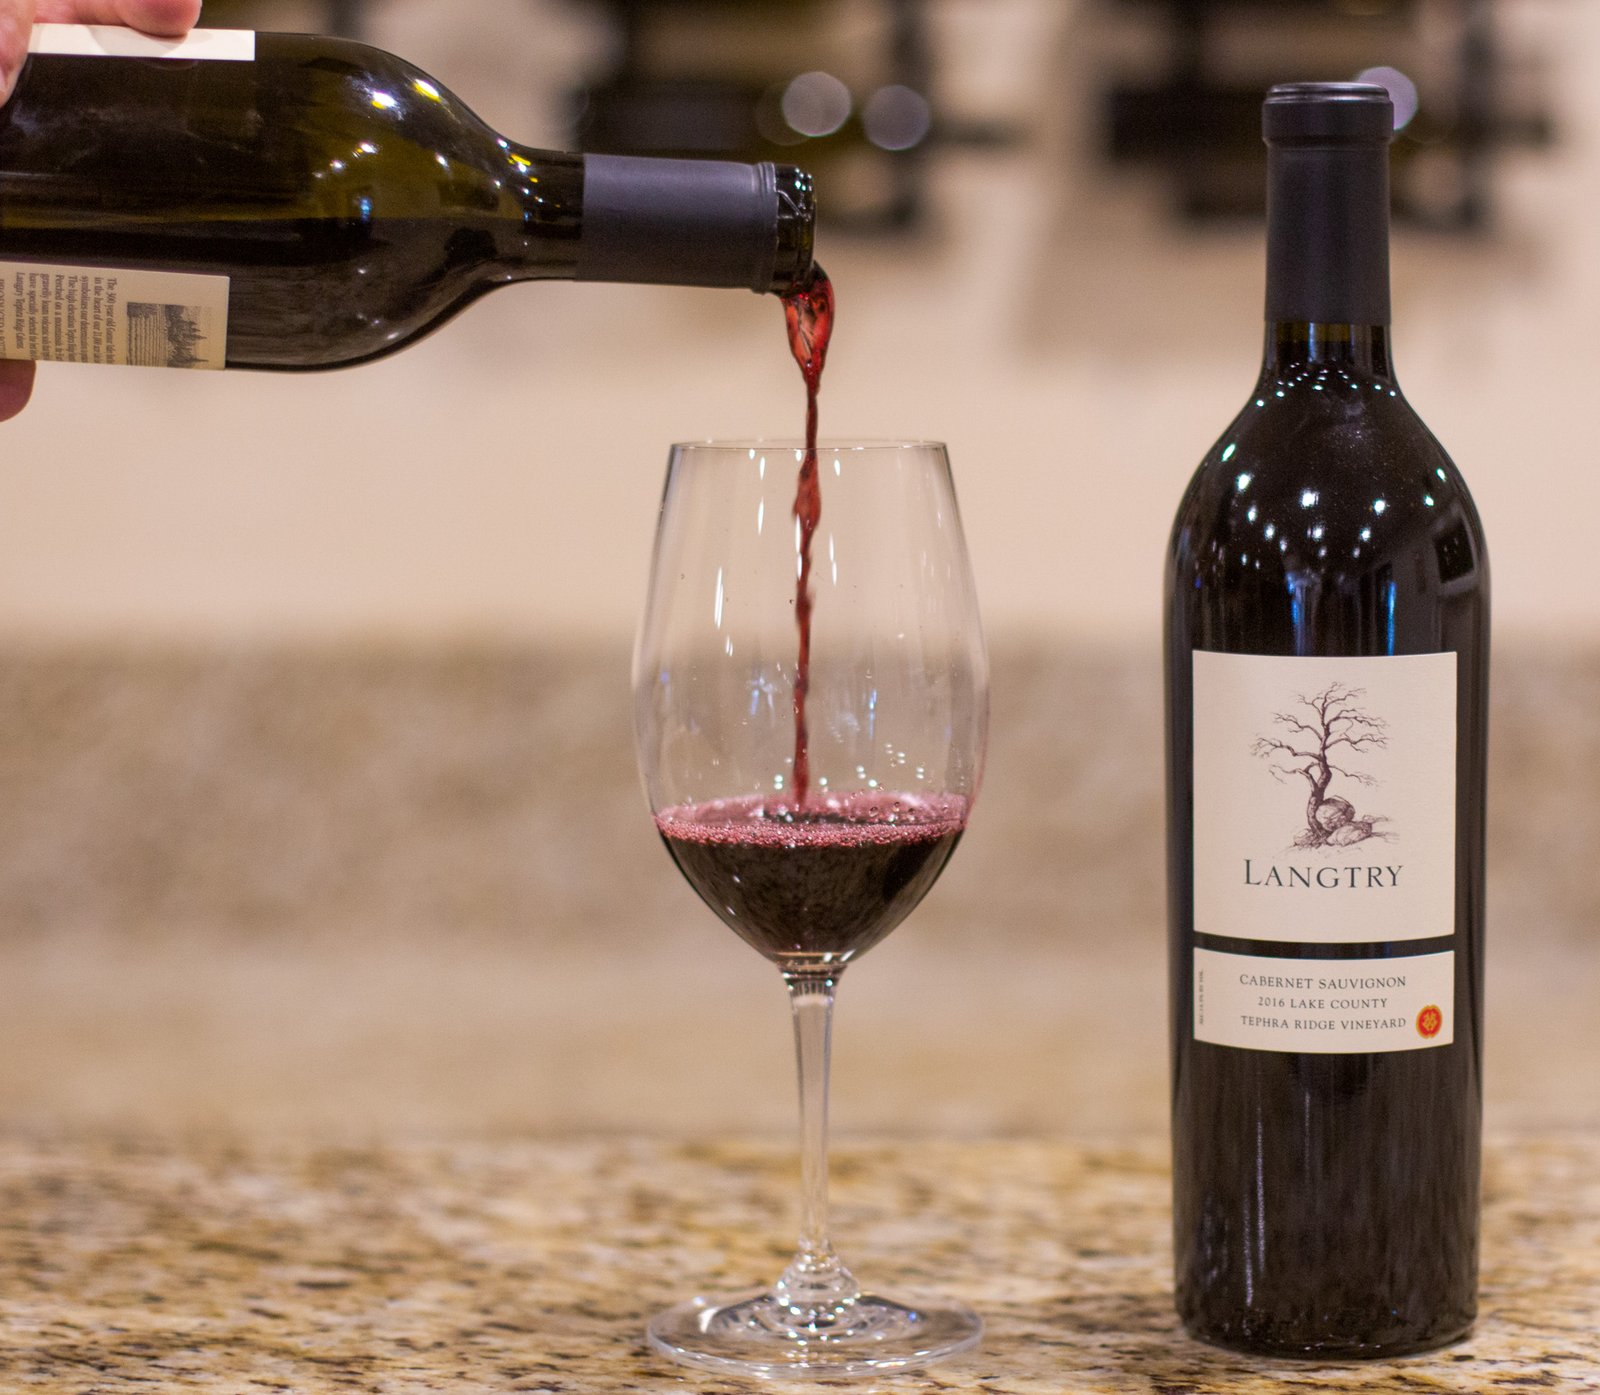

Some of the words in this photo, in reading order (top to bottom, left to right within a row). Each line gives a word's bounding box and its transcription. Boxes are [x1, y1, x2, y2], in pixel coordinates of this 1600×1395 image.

[14, 272, 26, 297] Langtry
[29, 273, 39, 288] have
[40, 274, 52, 298] gravelly
[55, 274, 65, 301] Perched
[68, 276, 78, 288] The
[93, 277, 104, 285] in
[107, 278, 117, 290] The
[66, 289, 78, 303] high
[80, 276, 91, 310] symbolizes
[93, 286, 104, 296] the
[14, 298, 26, 317] Tephra
[26, 290, 38, 315] specially
[42, 300, 51, 315] loam
[55, 302, 62, 310] on
[93, 297, 104, 313] heart
[67, 304, 77, 328] elevation
[104, 305, 114, 317] year
[93, 321, 101, 330] our
[106, 318, 116, 327] old
[1243, 858, 1404, 889] LANGTRY
[1239, 973, 1314, 990] CABERNET
[1318, 975, 1407, 990] SAUVIGNON
[1258, 996, 1286, 1008] 2016
[1290, 998, 1326, 1010] LAKE
[1330, 998, 1389, 1010] COUNTY
[1240, 1014, 1290, 1029] TEPHRA
[1294, 1017, 1336, 1031] RIDGE
[1341, 1016, 1408, 1031] VINEYARD
